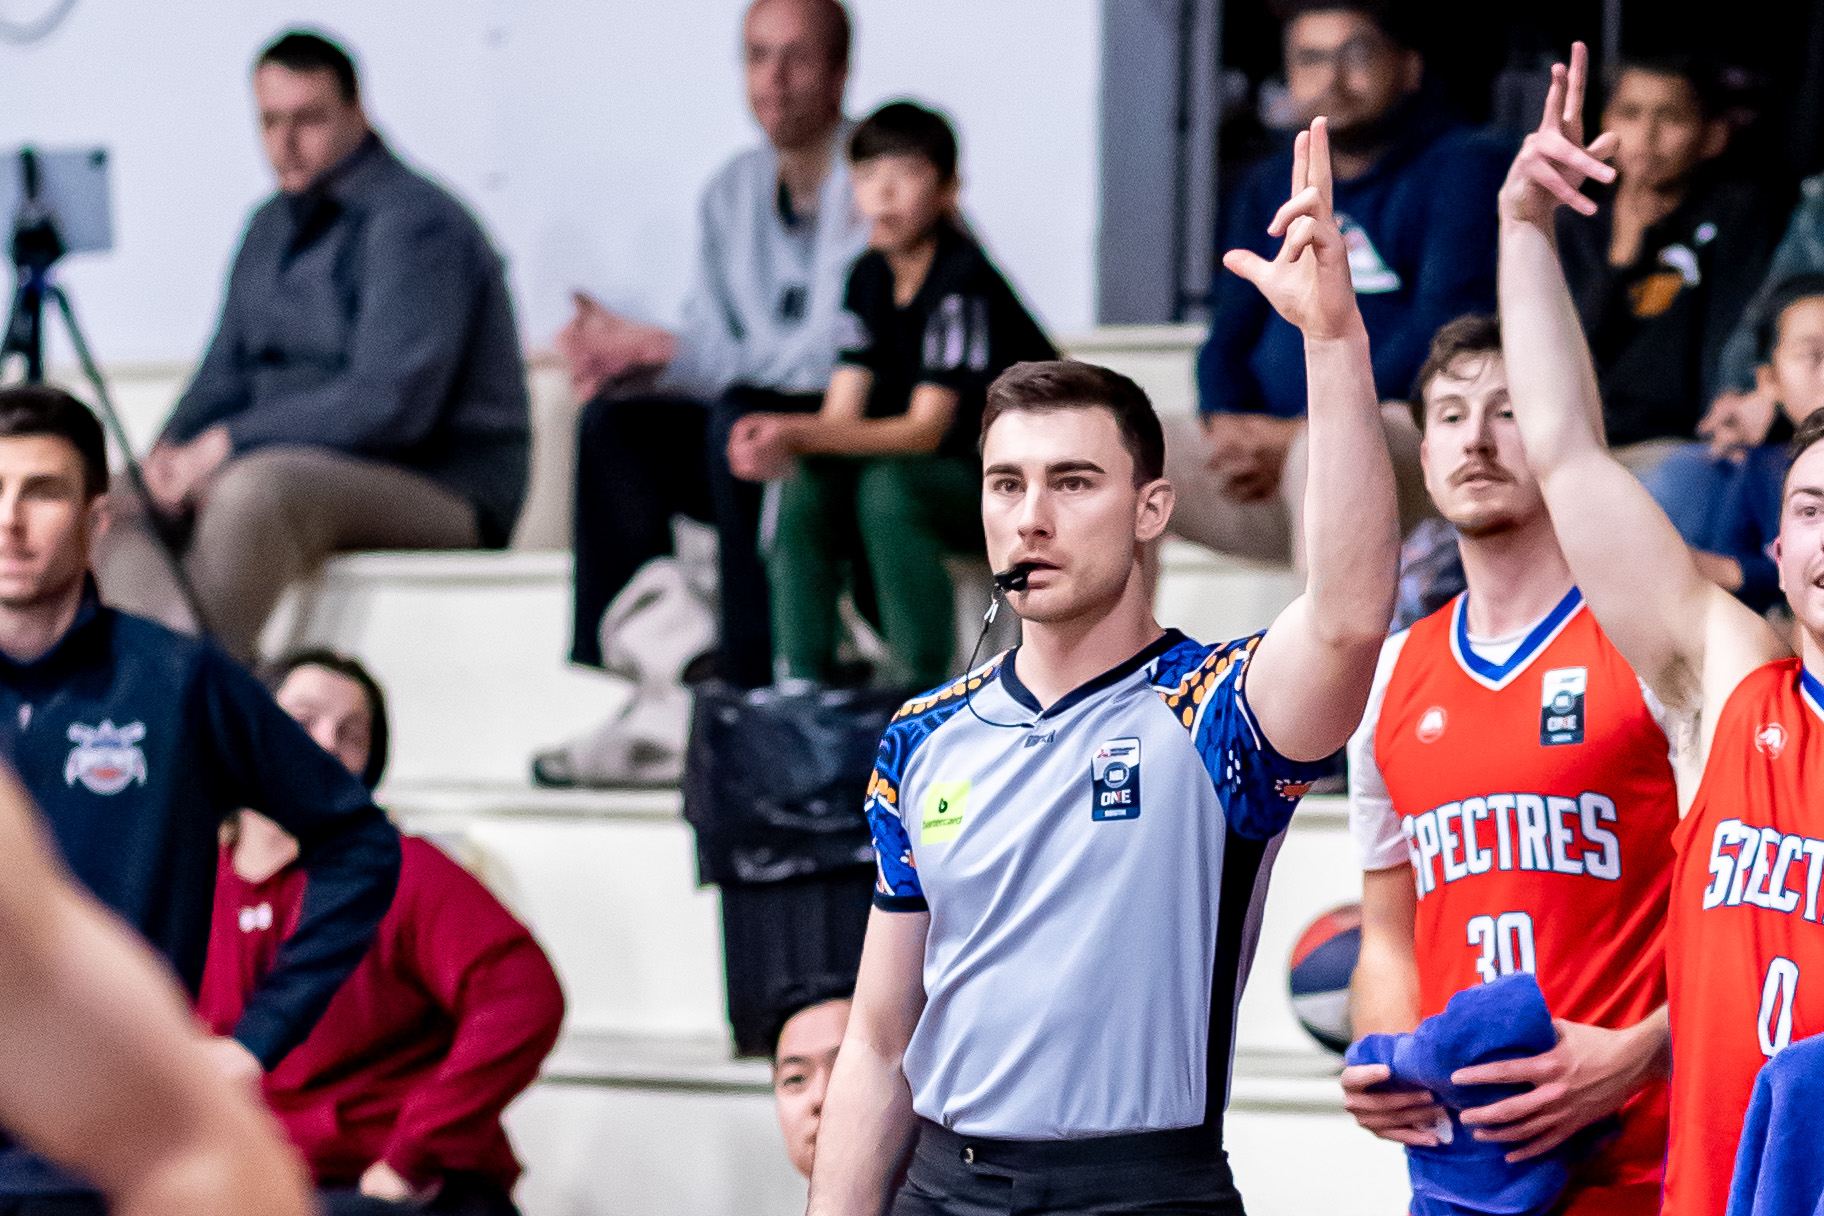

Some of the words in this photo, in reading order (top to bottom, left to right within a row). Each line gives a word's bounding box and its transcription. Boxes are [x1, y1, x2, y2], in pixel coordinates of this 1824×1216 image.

[1101, 789, 1132, 807] ONE
[1402, 792, 1622, 900] SPECTRES
[1467, 911, 1536, 984] 30
[1757, 956, 1799, 1057] 0
